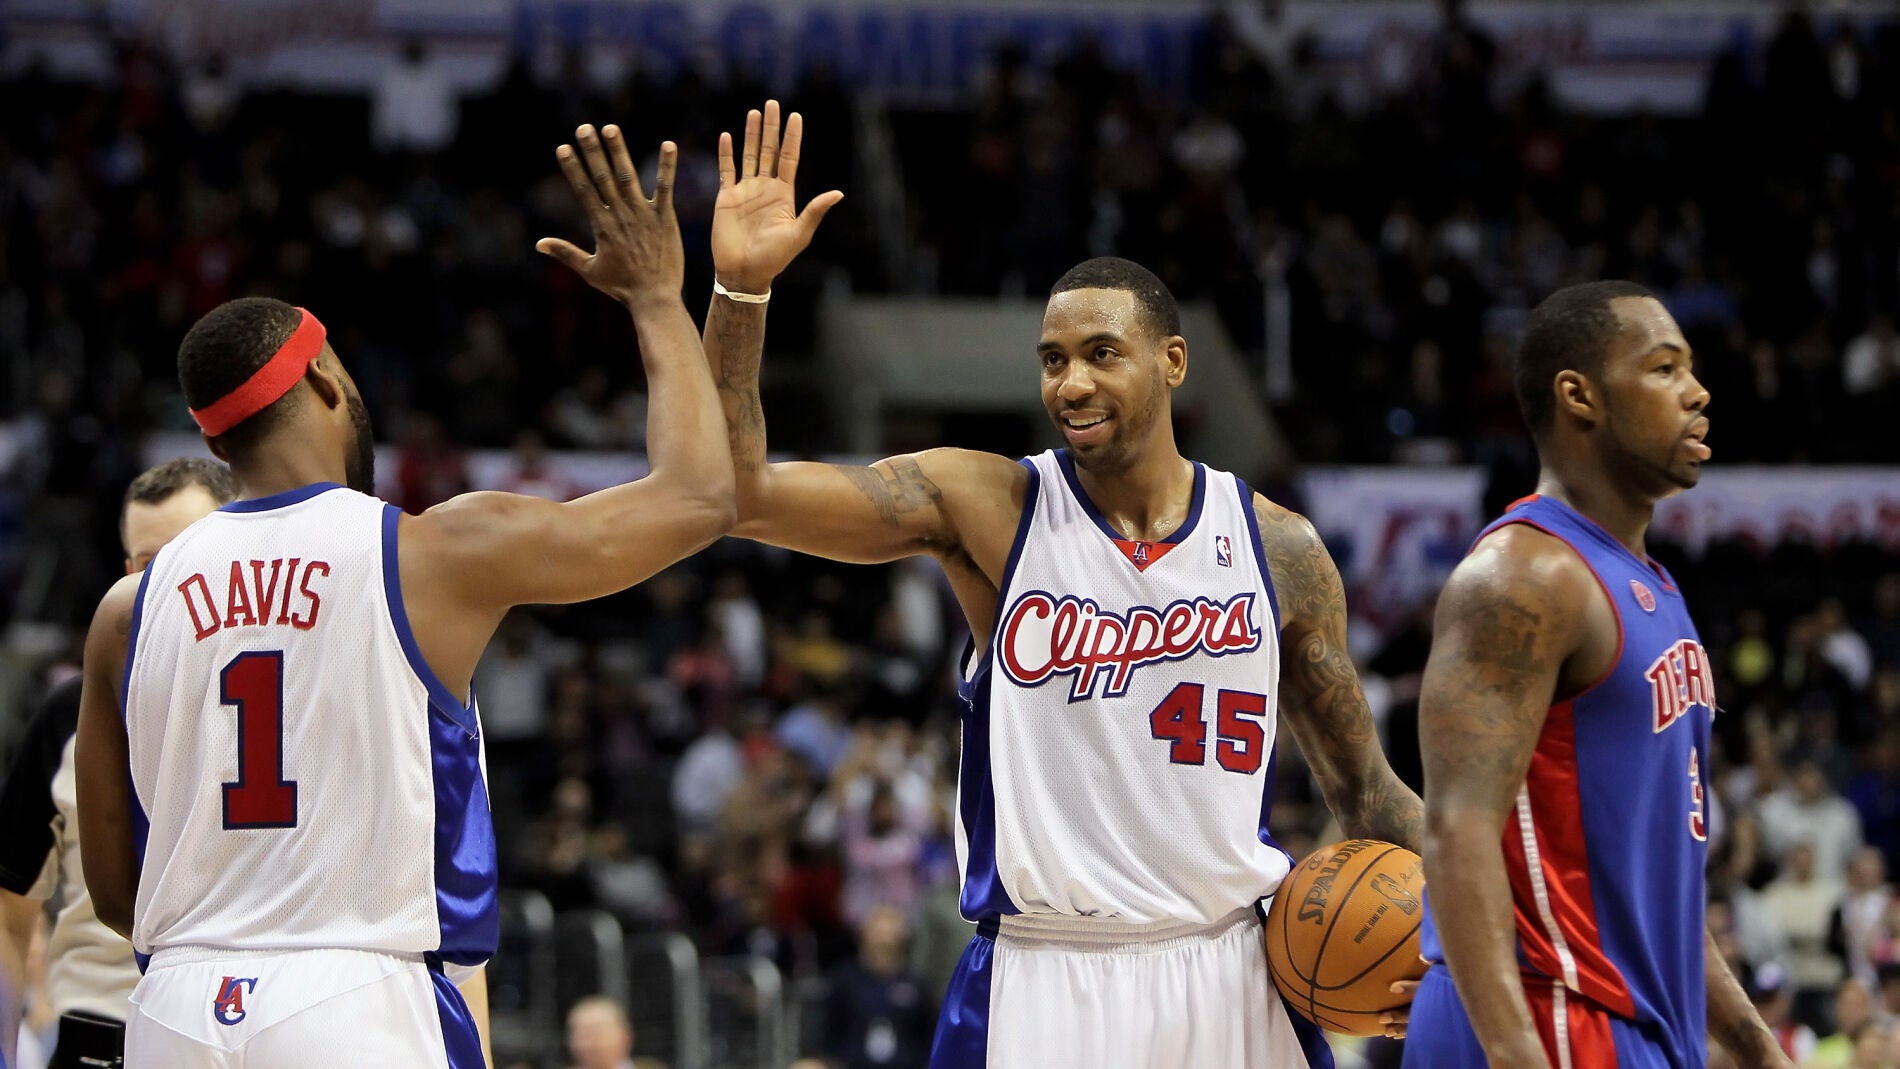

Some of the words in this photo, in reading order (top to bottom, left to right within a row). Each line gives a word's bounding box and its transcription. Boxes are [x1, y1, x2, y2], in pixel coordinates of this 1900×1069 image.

[177, 557, 331, 642] DAVIS
[997, 589, 1263, 704] Clippers
[220, 649, 298, 831] 1
[1149, 681, 1268, 776] 45
[1297, 840, 1377, 926] SPALDIN
